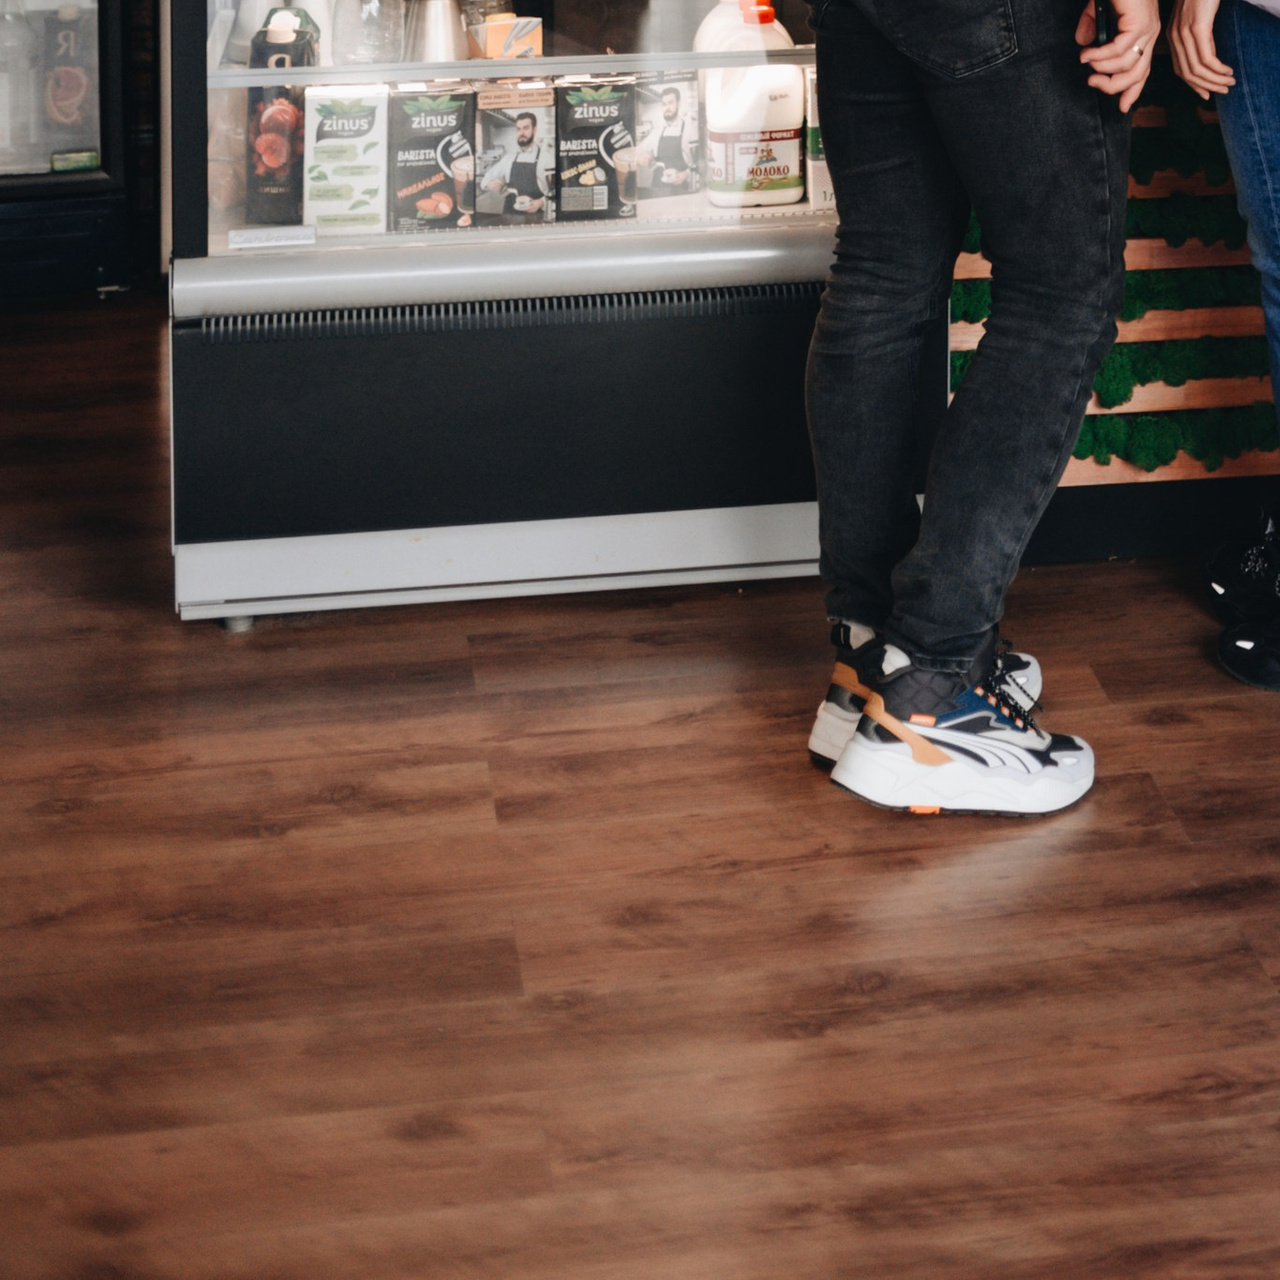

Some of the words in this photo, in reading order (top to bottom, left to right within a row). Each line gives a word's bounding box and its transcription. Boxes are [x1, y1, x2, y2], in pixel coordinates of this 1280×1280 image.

[574, 103, 619, 119] zinus
[323, 115, 369, 131] zinus
[411, 113, 457, 129] zinus
[560, 139, 598, 151] BARISTA
[397, 148, 436, 161] BARISTA
